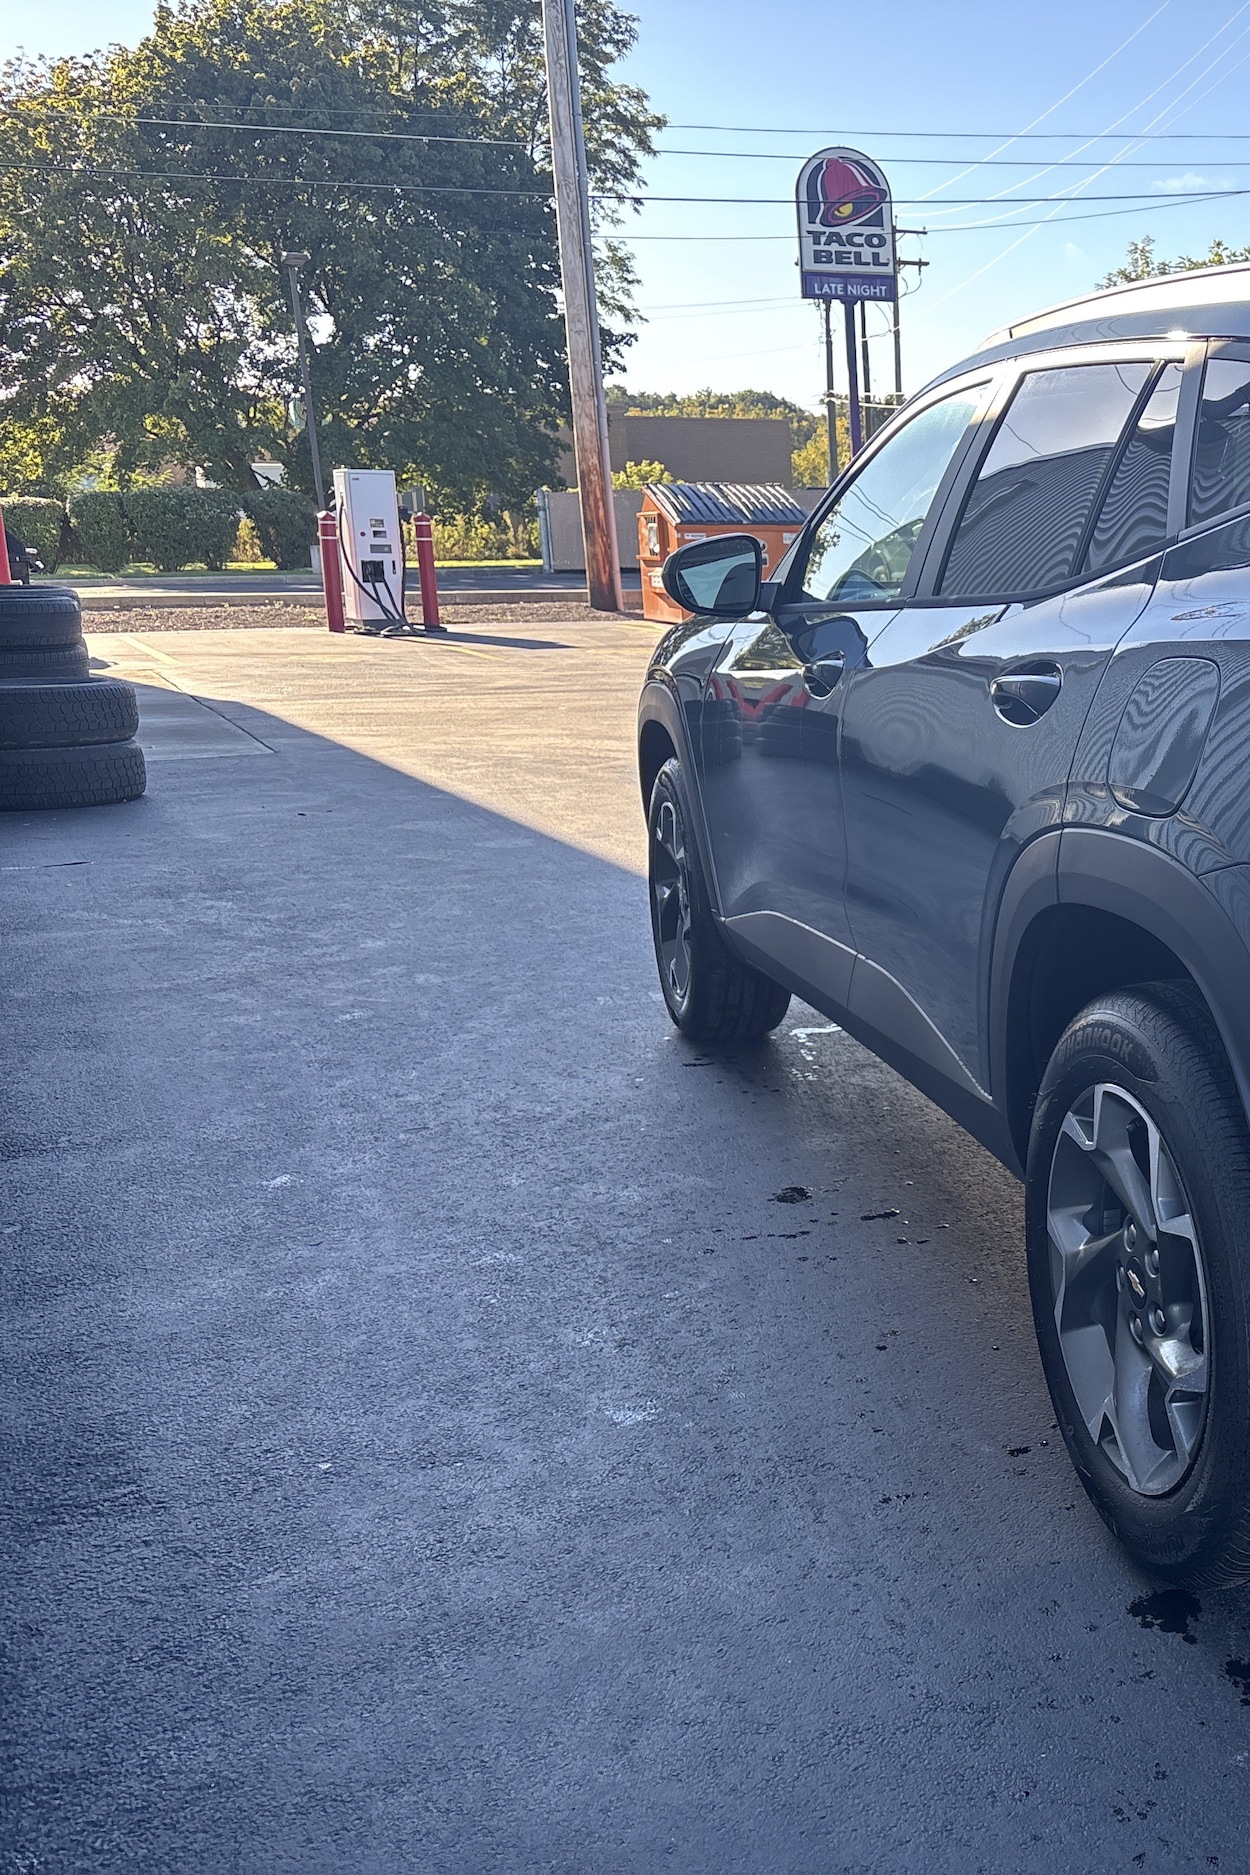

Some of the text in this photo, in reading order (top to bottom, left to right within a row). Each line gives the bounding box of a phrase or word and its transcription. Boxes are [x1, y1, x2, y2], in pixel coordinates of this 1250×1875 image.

[806, 230, 887, 248] TACO
[813, 249, 890, 267] BELL
[814, 283, 888, 297] LATE NIGHT
